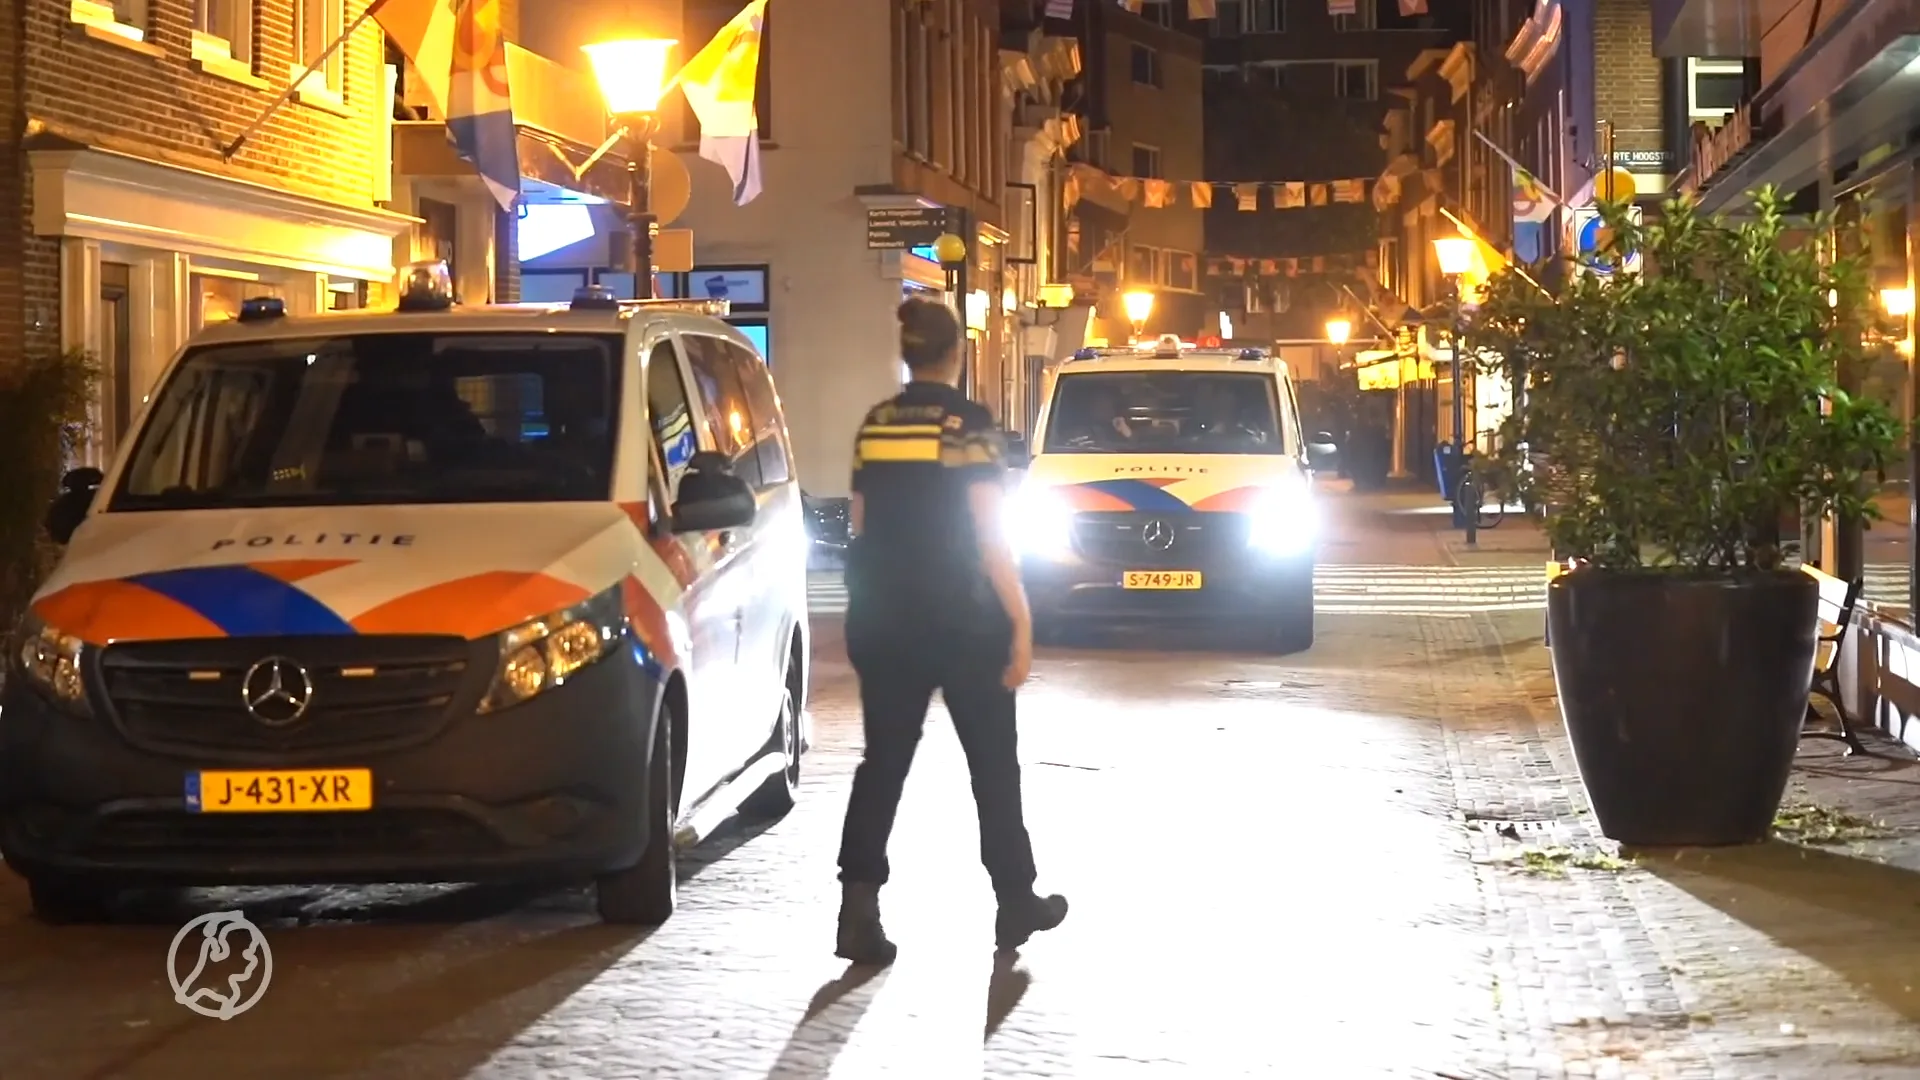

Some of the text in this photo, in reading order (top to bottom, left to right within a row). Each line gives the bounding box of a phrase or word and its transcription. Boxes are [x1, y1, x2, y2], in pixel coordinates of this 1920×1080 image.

[1604, 152, 1631, 161] RTE
[211, 532, 416, 551] POLITIE
[1129, 573, 1195, 586] S-749-JR
[218, 775, 352, 805] J-431-XR
